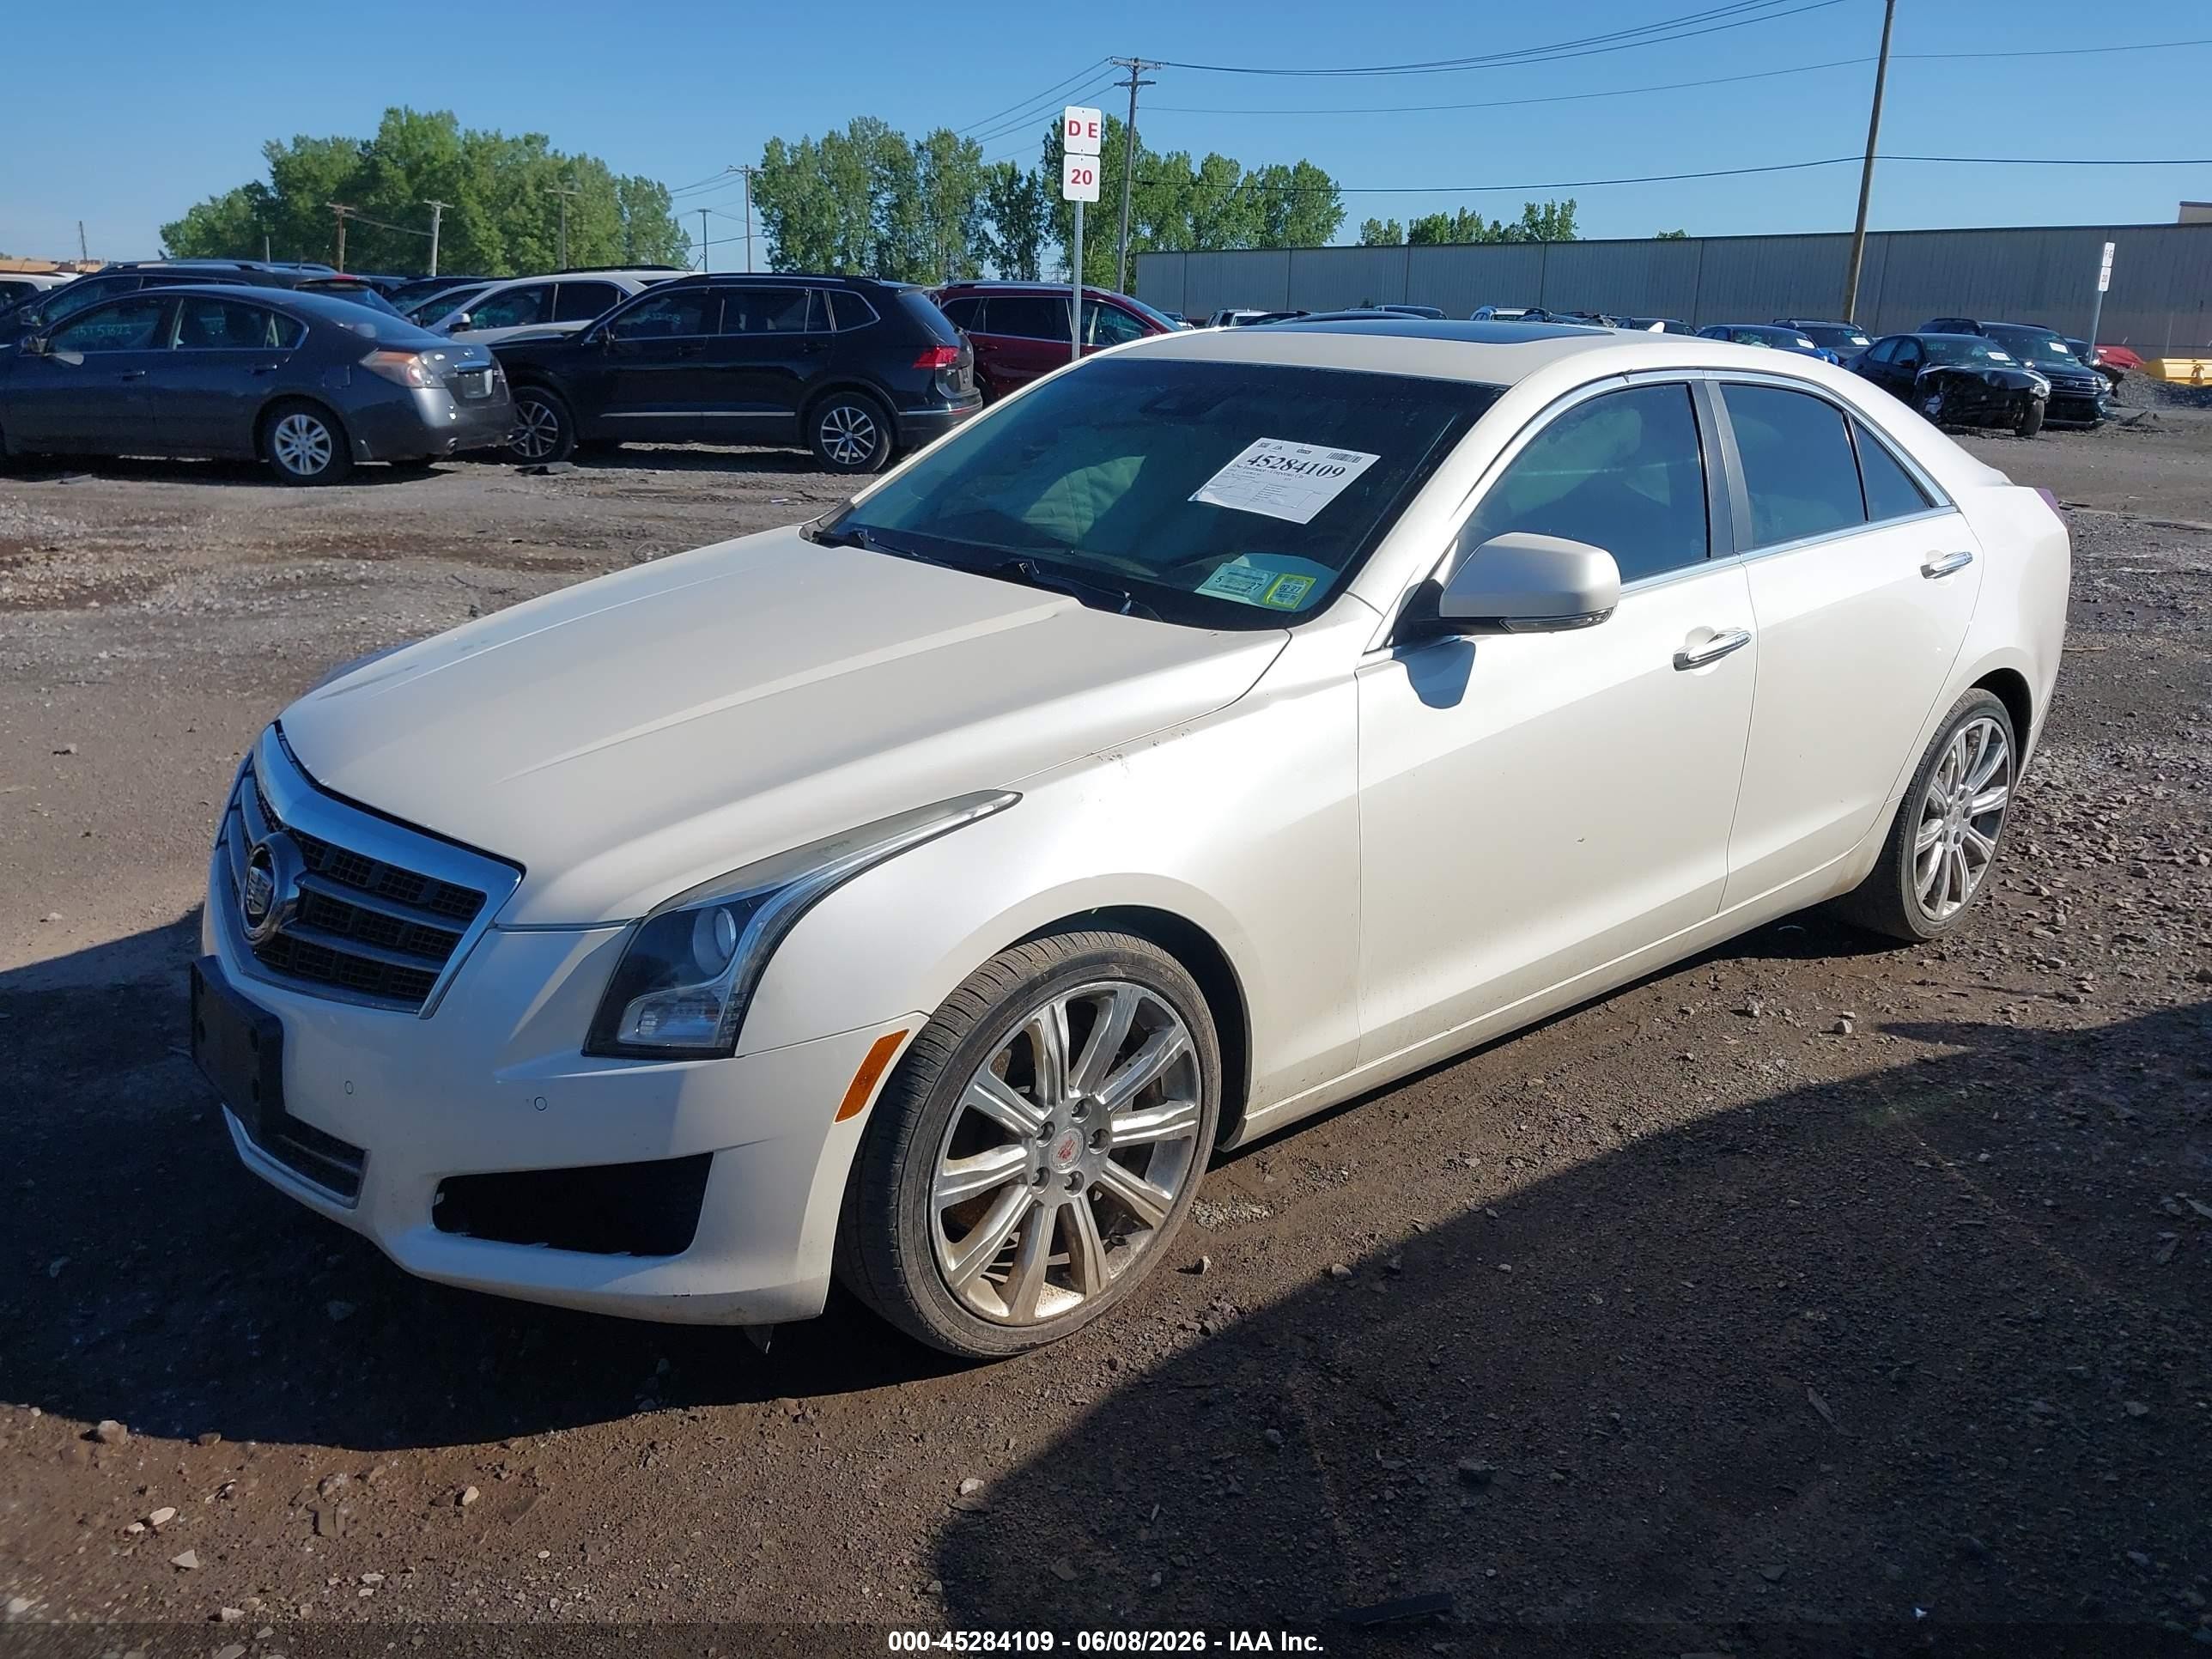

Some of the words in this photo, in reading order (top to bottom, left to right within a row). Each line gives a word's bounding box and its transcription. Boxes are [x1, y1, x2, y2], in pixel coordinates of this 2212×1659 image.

[1068, 120, 1081, 137] D
[1088, 122, 1097, 138] E
[1071, 168, 1092, 185] 20
[1246, 453, 1346, 479] 45284109
